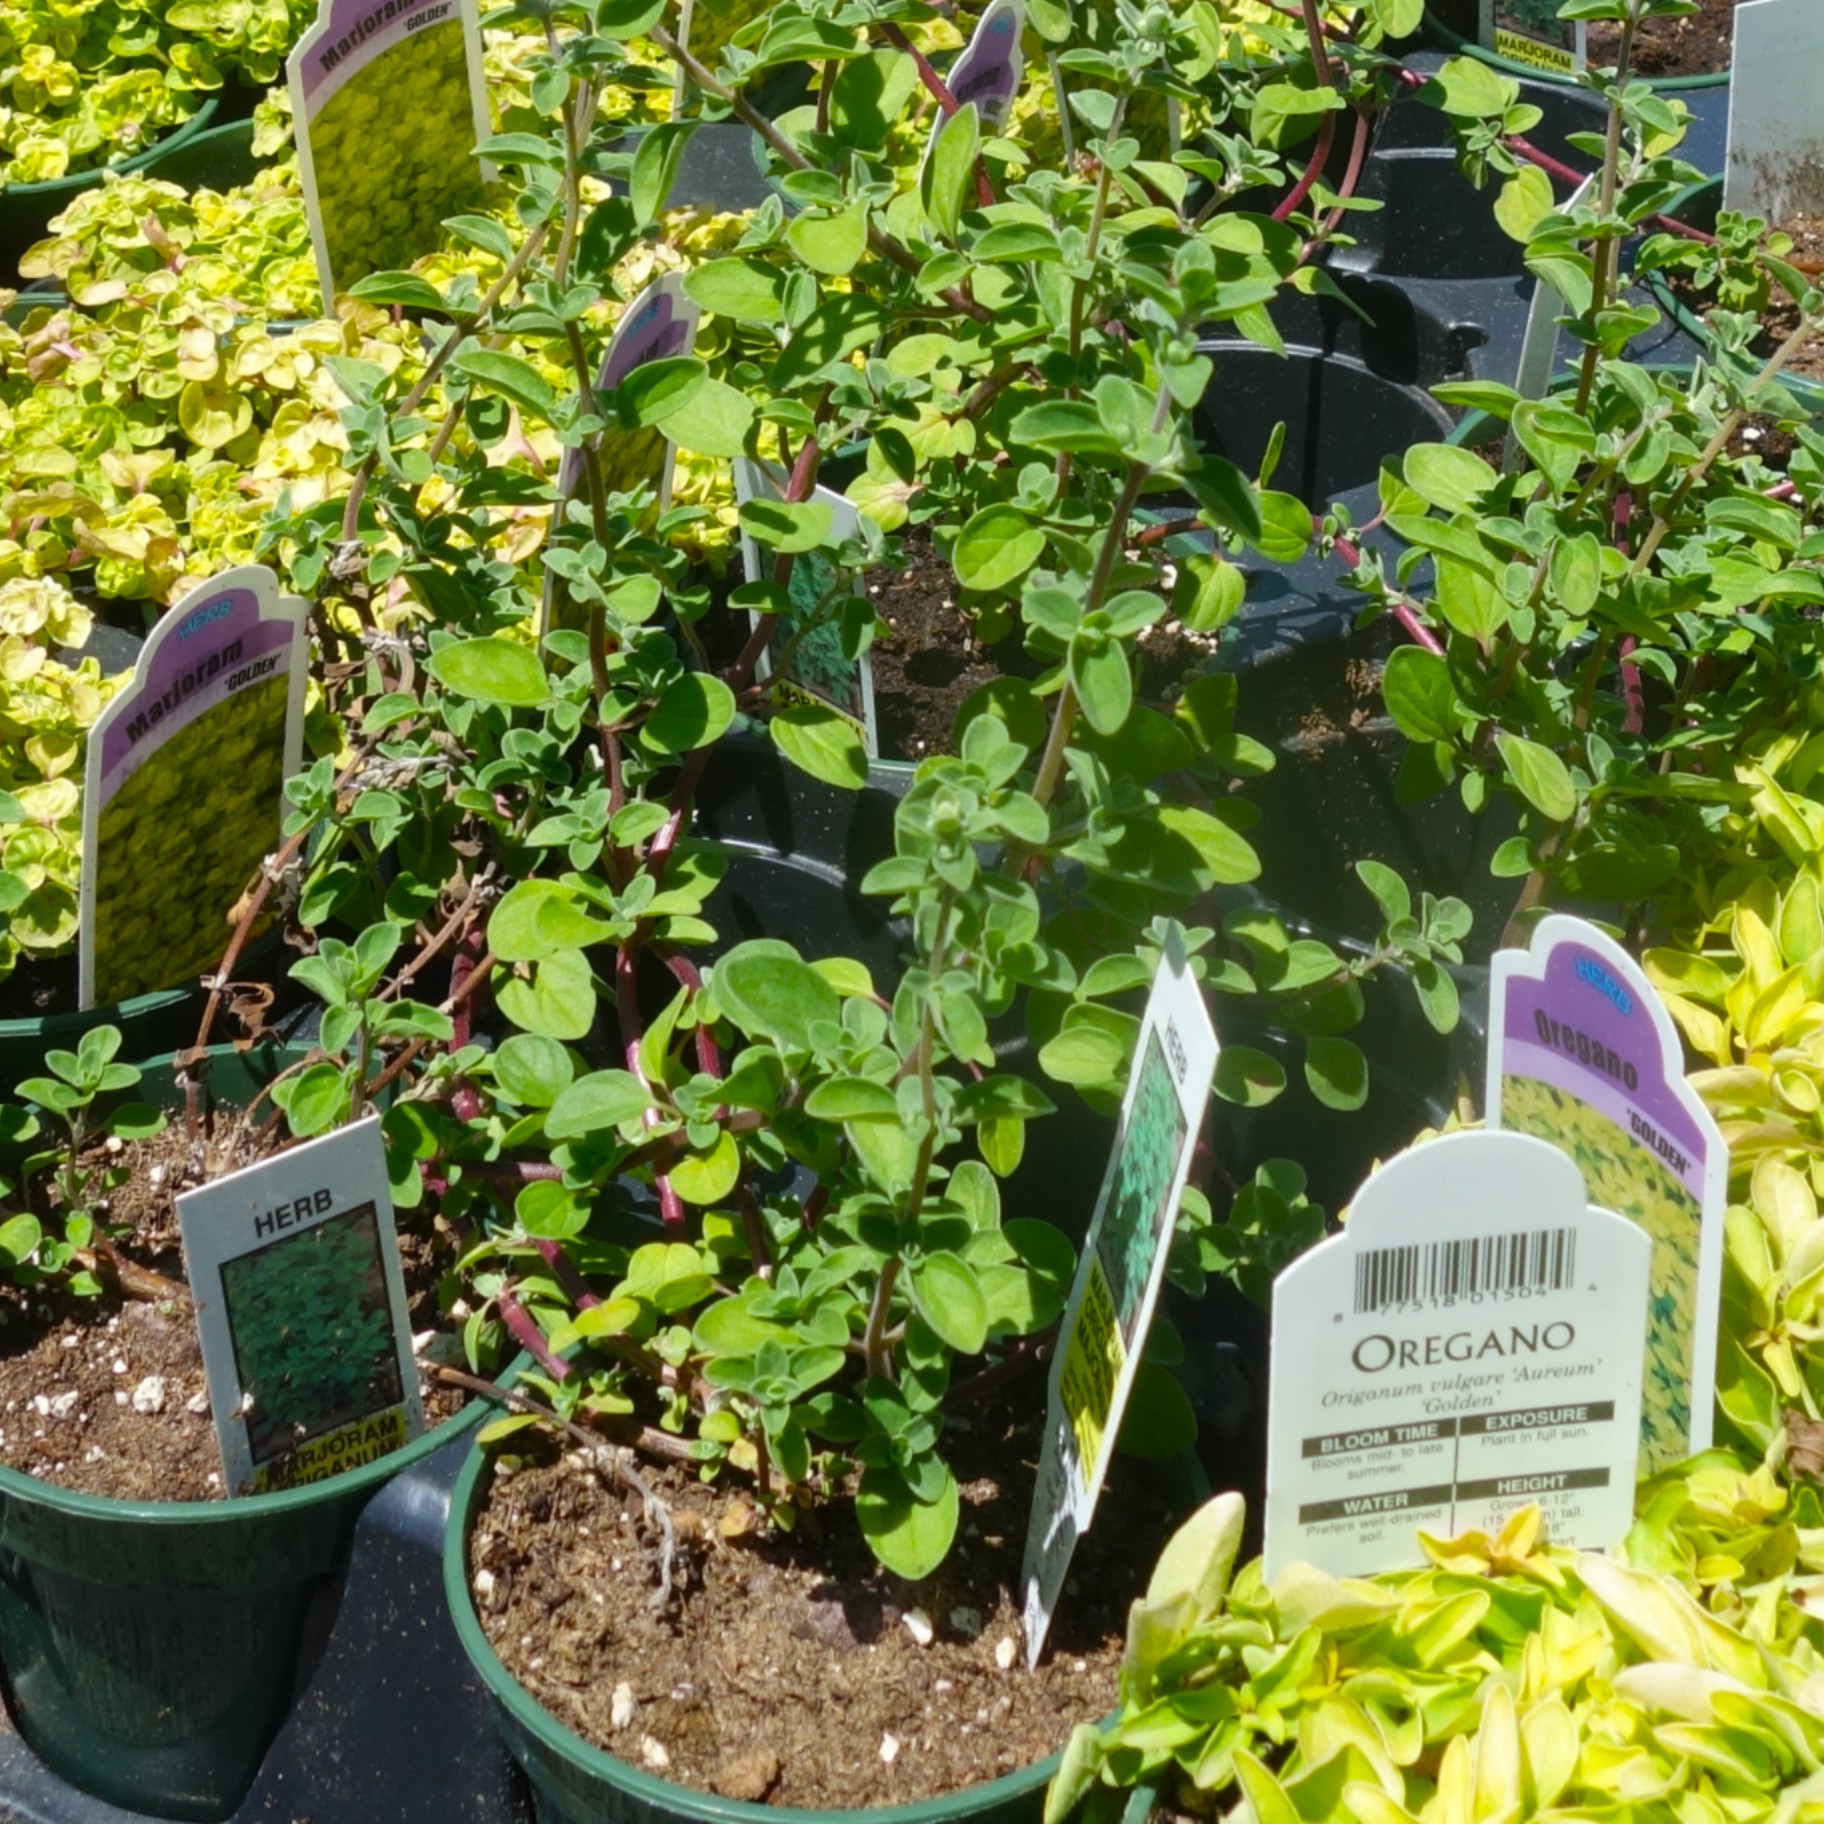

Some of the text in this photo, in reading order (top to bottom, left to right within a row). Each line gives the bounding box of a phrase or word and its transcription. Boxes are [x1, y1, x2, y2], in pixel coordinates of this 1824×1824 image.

[1498, 35, 1572, 70] MARJORAM
[178, 598, 234, 642] HERB
[125, 637, 244, 745] Marjoram
[1575, 954, 1634, 1019] HERB
[1164, 1013, 1189, 1086] HERB
[1533, 1008, 1640, 1093] Oregano
[253, 1188, 334, 1239] HERB
[1380, 1295, 1457, 1317] 77518
[1468, 1286, 1549, 1306] 01504
[1351, 1321, 1576, 1373] OREGANO
[1321, 1381, 1423, 1409] Origanum
[1430, 1372, 1506, 1395] vulgare
[1485, 1406, 1589, 1432] EXPOSURE
[1320, 1423, 1439, 1454] BLOOM TIME
[1481, 1425, 1590, 1448] Plant in full sun.
[1311, 1453, 1363, 1472] Blooms
[1401, 1447, 1415, 1459] to
[1418, 1442, 1444, 1457] late
[1347, 1464, 1406, 1481] summer.
[1496, 1474, 1569, 1495] HEIGHT
[1343, 1493, 1410, 1515] WATER
[1306, 1508, 1442, 1539] Prefers well-drained
